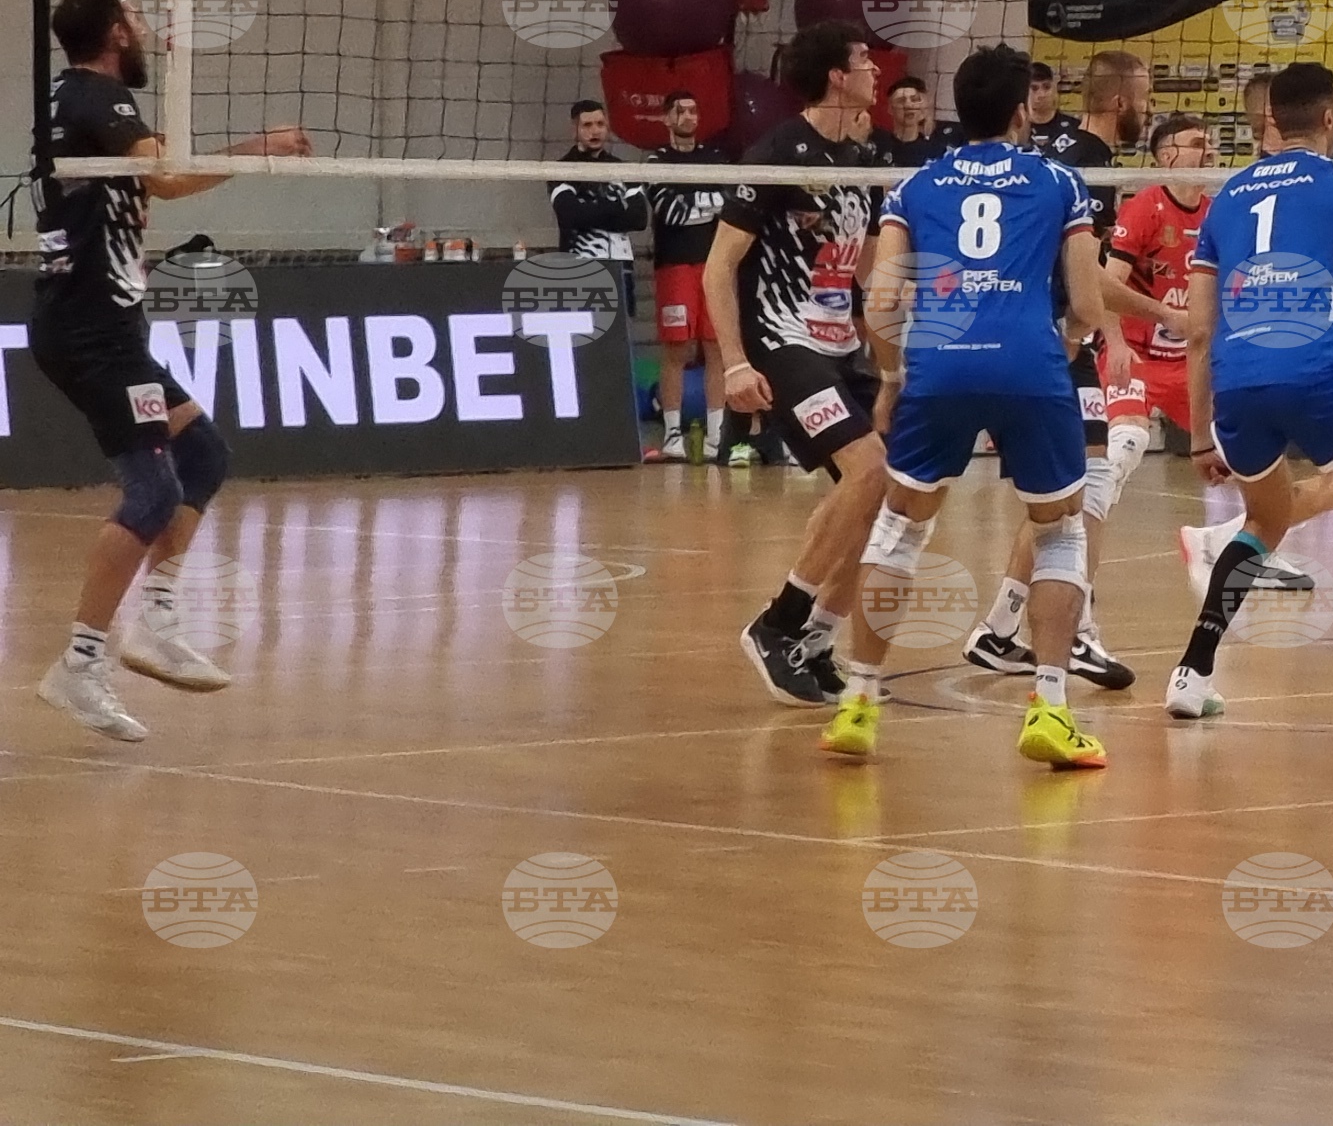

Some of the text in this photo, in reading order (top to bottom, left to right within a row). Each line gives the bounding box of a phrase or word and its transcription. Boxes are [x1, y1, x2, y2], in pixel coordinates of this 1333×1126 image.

[1229, 174, 1314, 197] VIVACOM
[958, 193, 1002, 259] 8
[1250, 194, 1277, 254] 1
[962, 270, 998, 281] PIPE
[1242, 271, 1298, 288] SYSTEM
[961, 279, 1022, 293] SYSTEM
